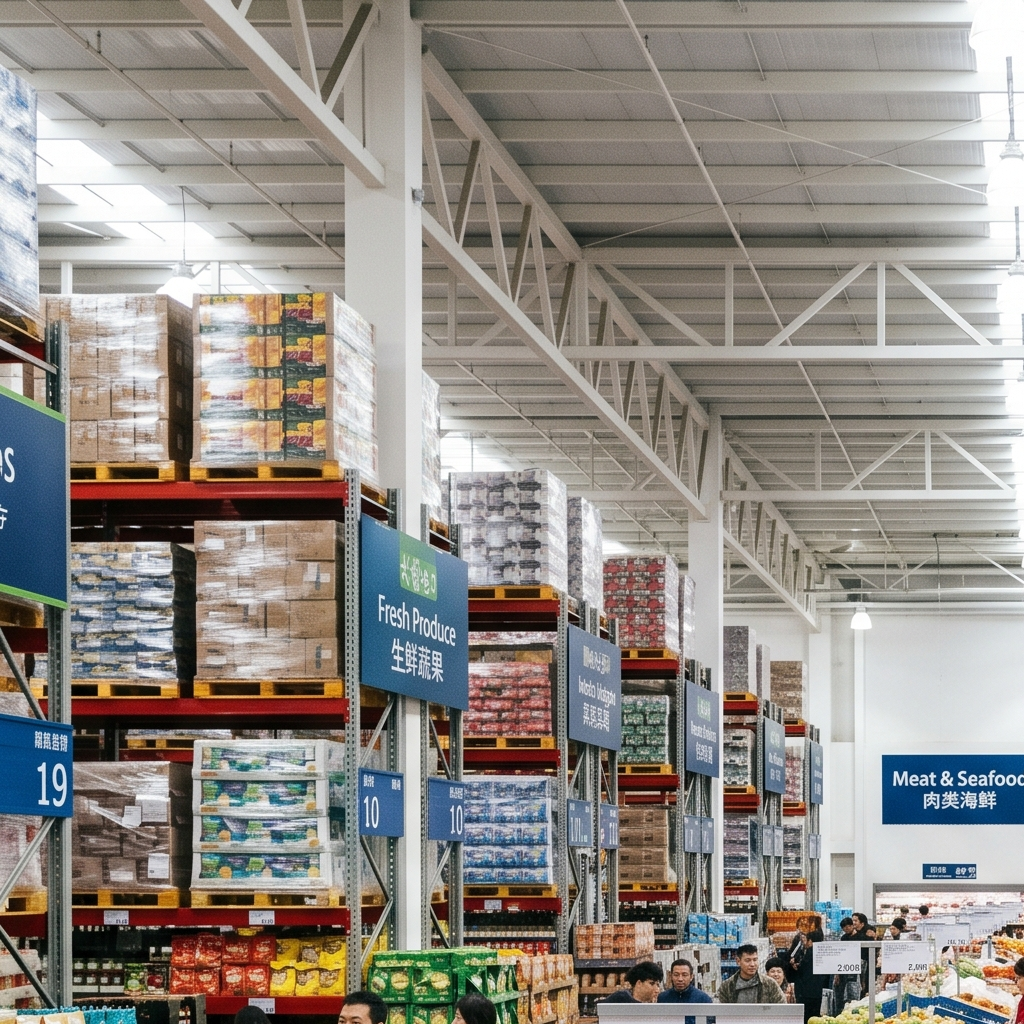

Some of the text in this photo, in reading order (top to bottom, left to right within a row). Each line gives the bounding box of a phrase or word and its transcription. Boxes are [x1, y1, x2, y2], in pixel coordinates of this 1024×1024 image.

[378, 593, 456, 647] Fresh Produce
[37, 762, 68, 808] 19
[892, 770, 937, 787] Meat
[940, 770, 954, 787] &
[363, 795, 380, 829] 10
[449, 804, 463, 835] 10
